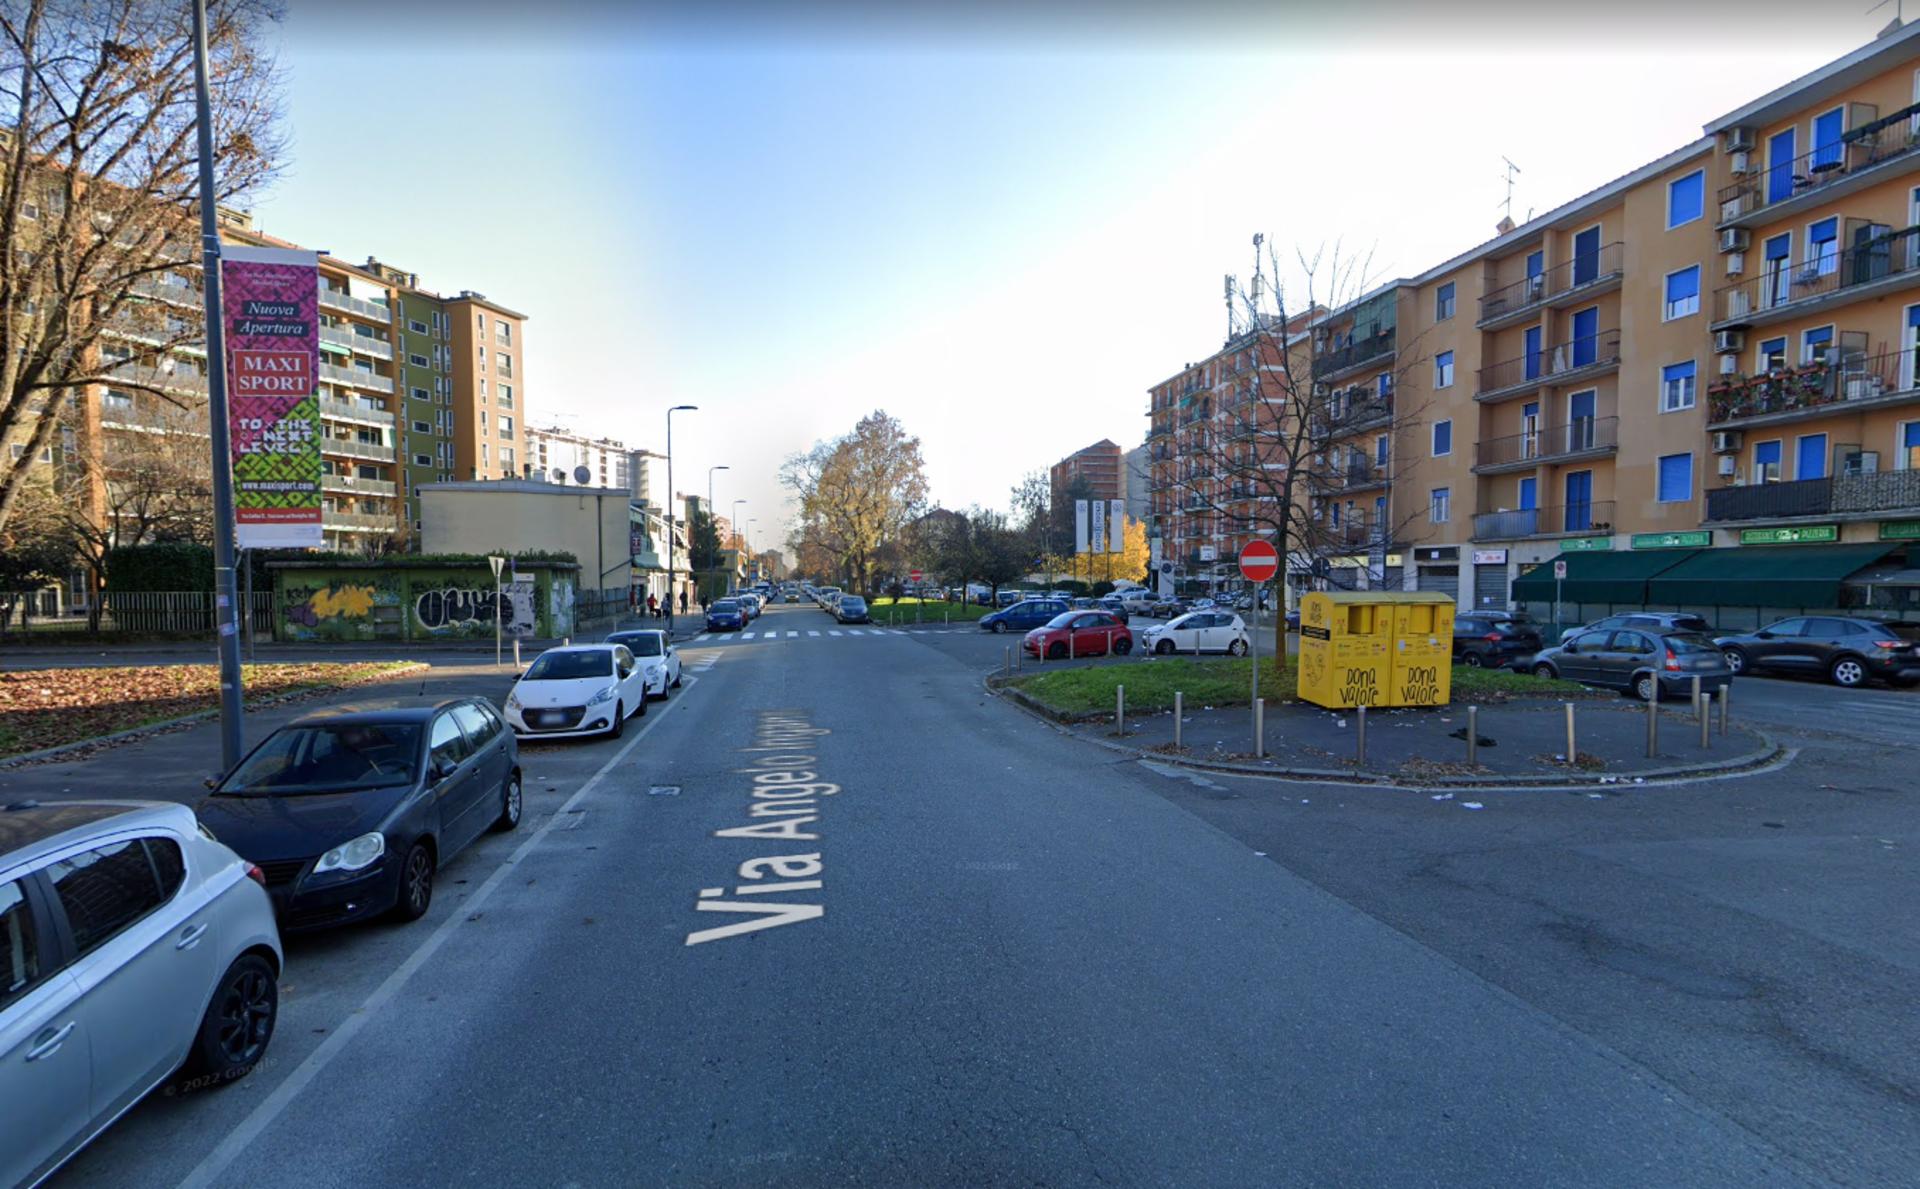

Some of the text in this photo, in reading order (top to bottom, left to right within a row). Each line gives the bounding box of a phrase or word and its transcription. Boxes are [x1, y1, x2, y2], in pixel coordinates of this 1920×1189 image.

[248, 302, 294, 315] Nuova
[240, 320, 303, 336] Apertura
[244, 356, 302, 372] MAXI
[239, 376, 307, 390] SPORT
[240, 418, 311, 430] TO THE
[263, 431, 312, 442] NEXT
[240, 441, 301, 453] LEVEL
[242, 481, 315, 491] www.maxisport.com
